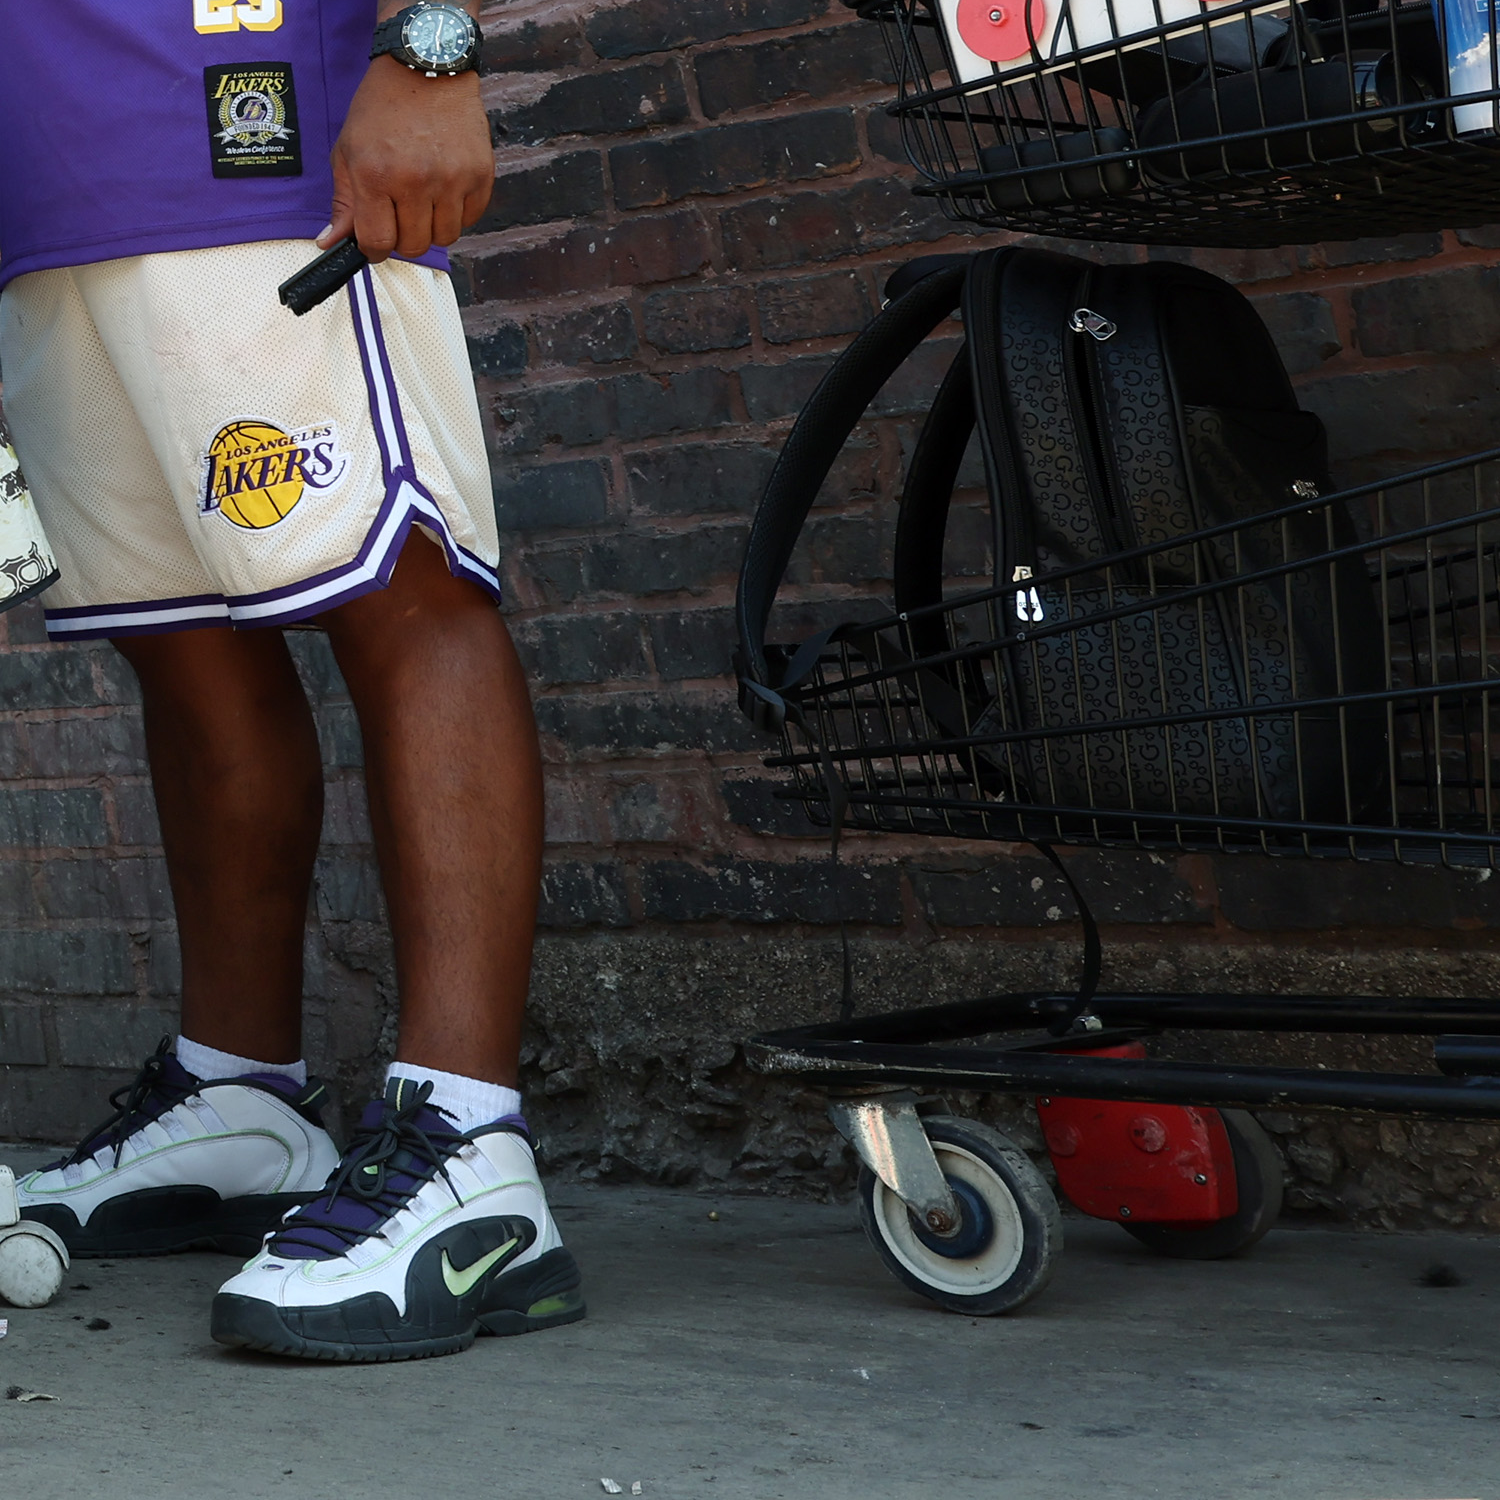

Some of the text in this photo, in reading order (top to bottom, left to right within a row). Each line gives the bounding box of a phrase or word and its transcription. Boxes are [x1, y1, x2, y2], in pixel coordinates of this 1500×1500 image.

[211, 74, 290, 99] LAKERS
[226, 426, 333, 460] LOS ANGELES
[201, 441, 346, 513] LAKERS
